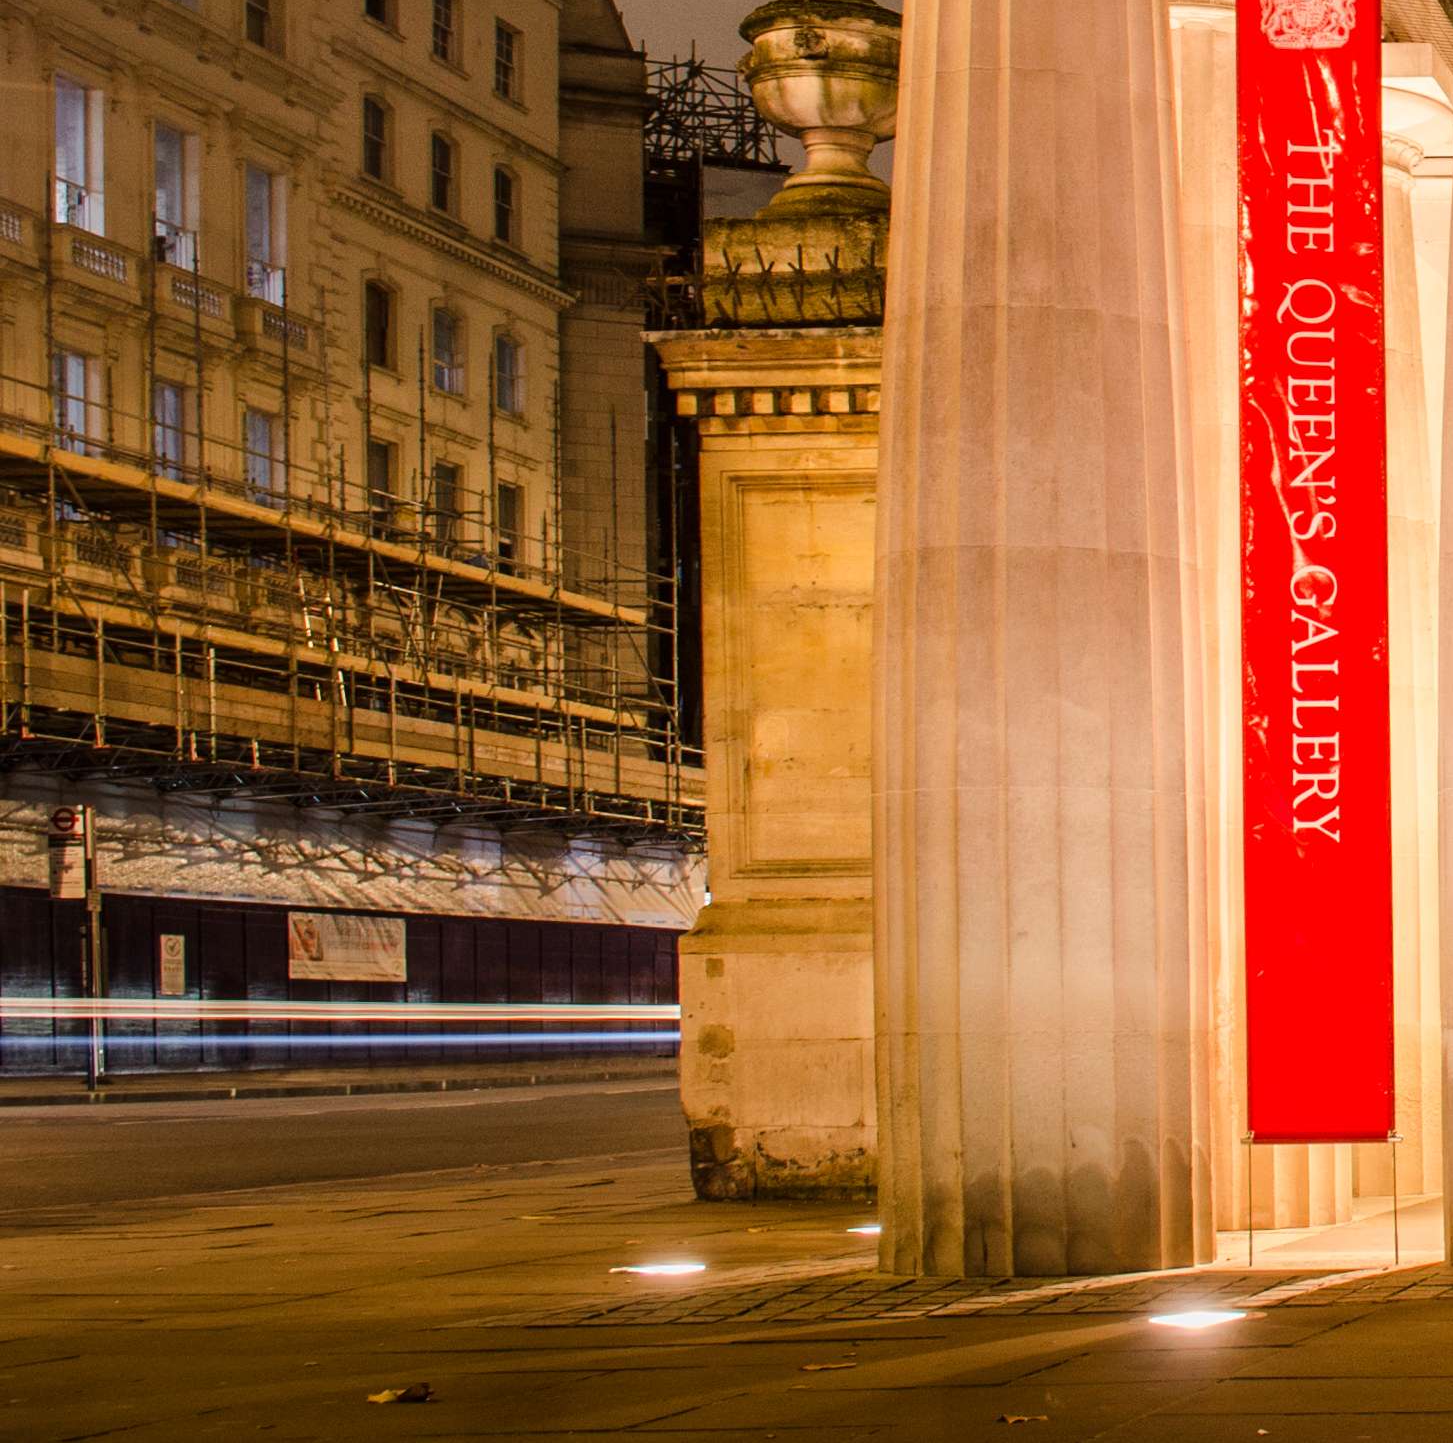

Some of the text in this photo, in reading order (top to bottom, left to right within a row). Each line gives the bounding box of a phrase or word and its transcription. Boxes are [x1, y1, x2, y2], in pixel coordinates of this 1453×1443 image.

[1276, 129, 1341, 844] THE QUEEN'S GALLERY
